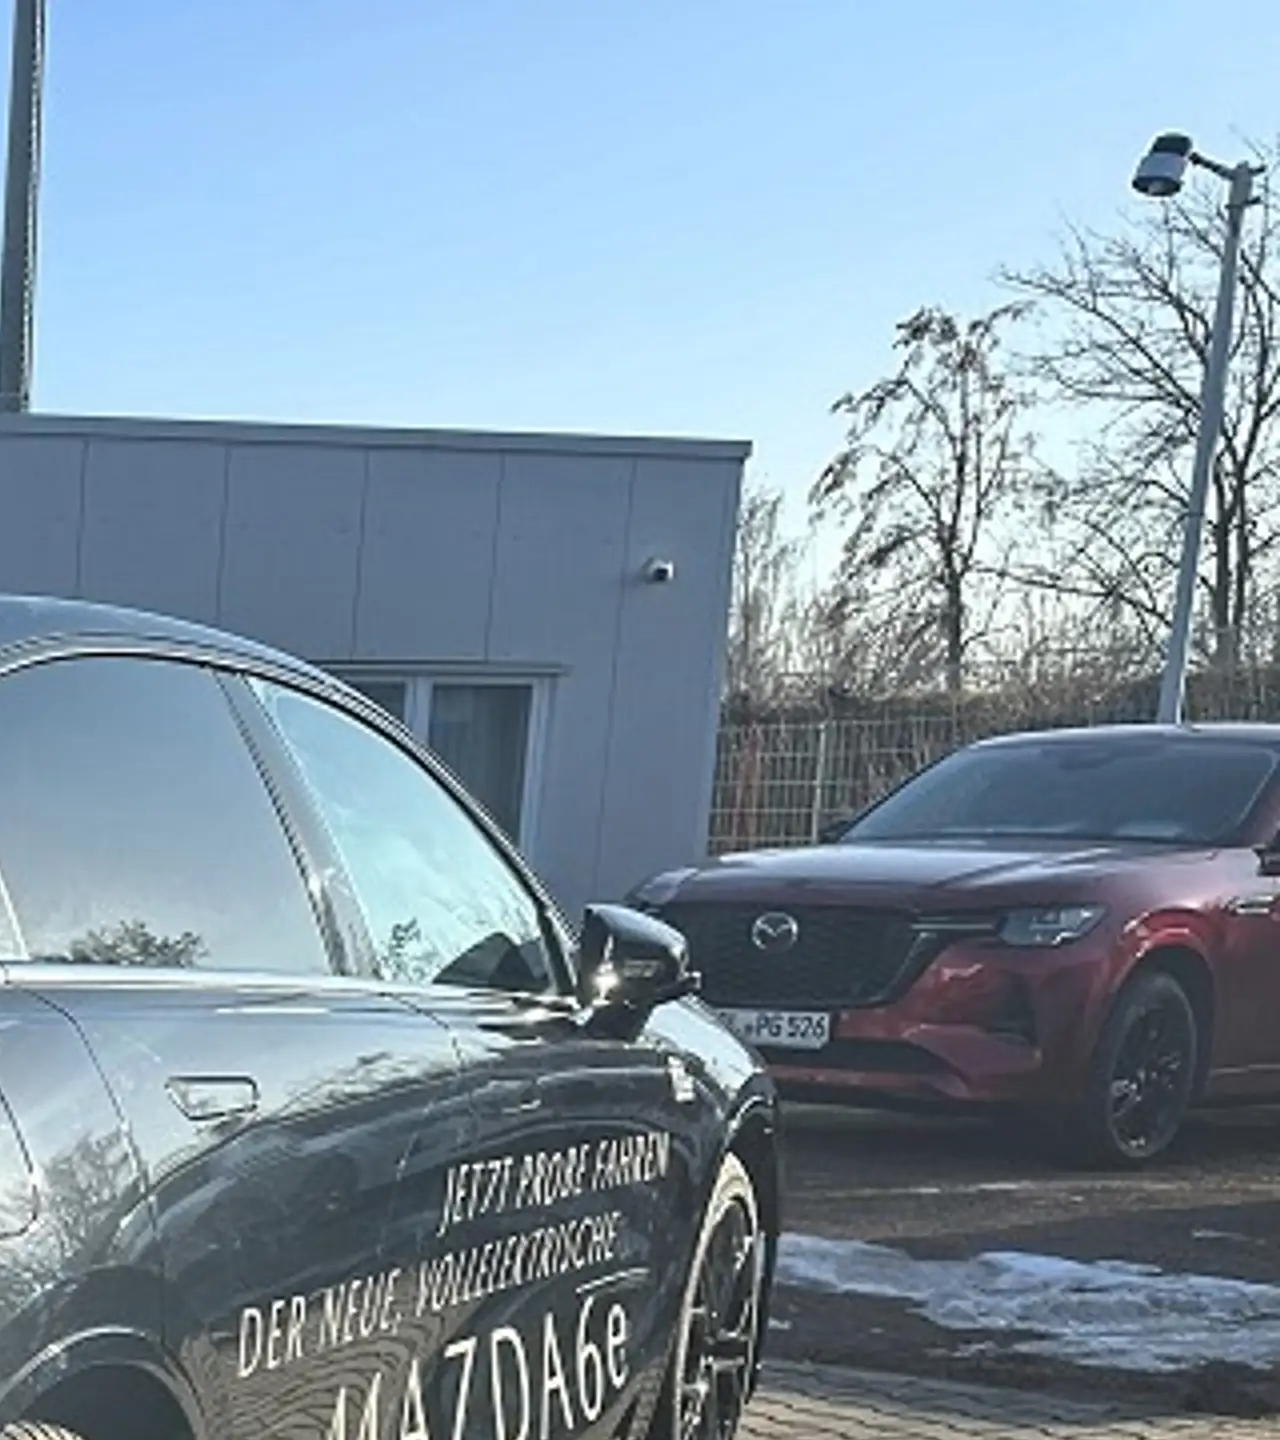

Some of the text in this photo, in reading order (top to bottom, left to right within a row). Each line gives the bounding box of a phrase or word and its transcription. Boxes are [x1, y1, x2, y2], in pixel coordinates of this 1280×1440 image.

[437, 1131, 671, 1238] JETZT PROBE FAHREN
[240, 1296, 306, 1379] DER
